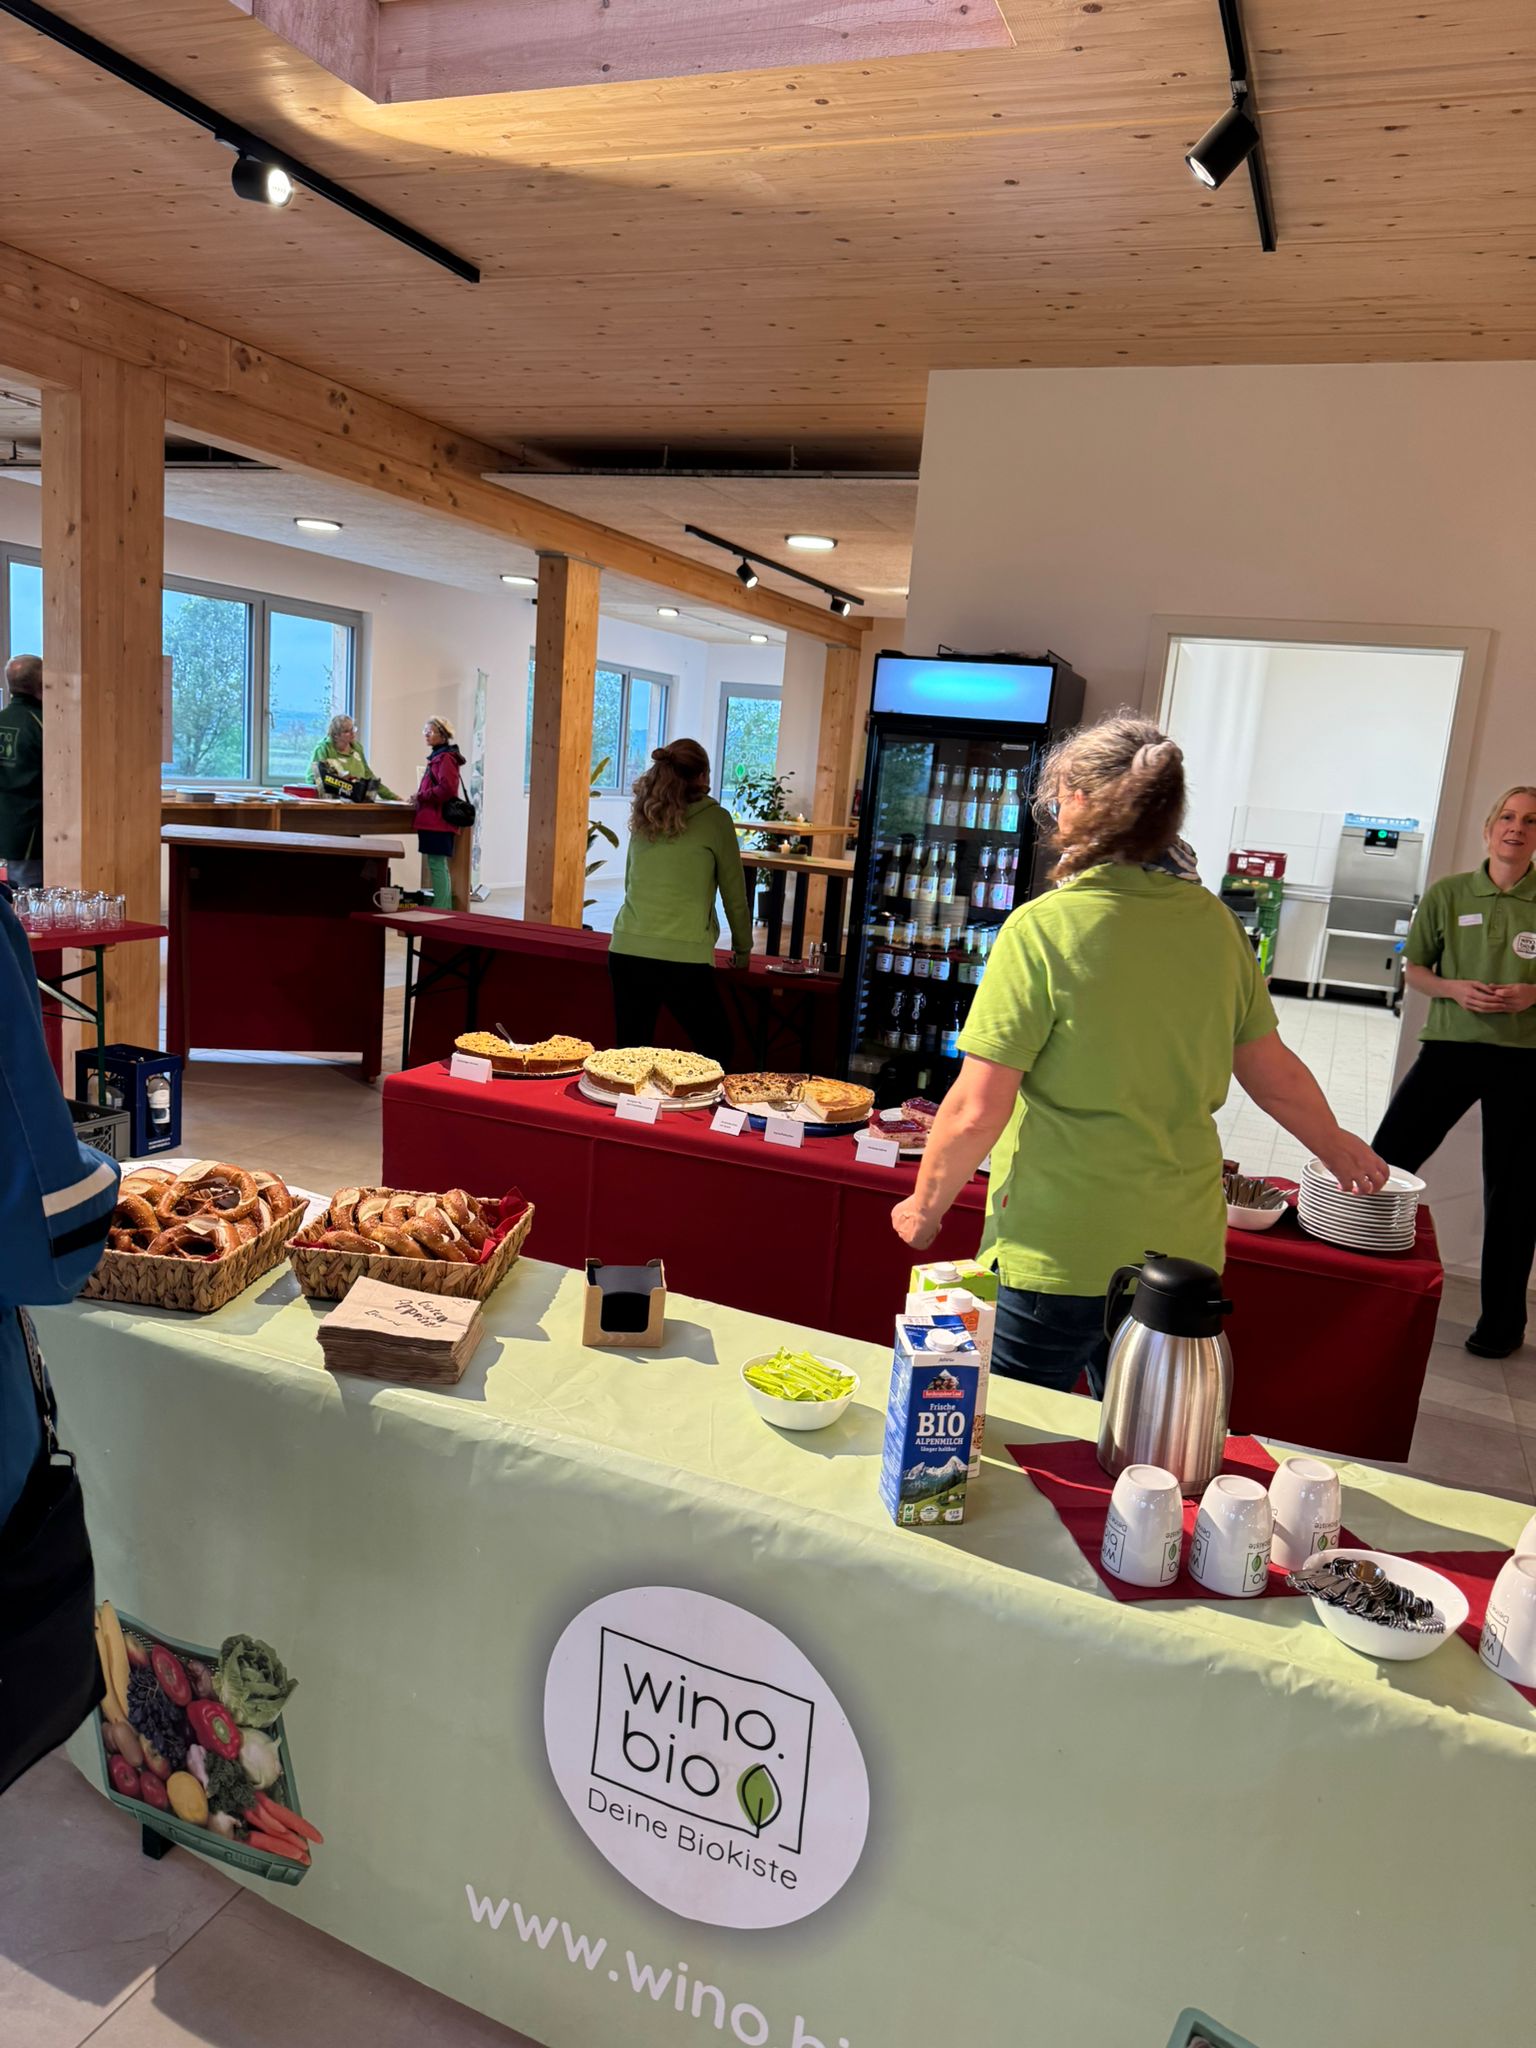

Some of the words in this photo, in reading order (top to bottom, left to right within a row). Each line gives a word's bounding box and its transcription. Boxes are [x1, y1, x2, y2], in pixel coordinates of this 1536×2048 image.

[916, 1411, 966, 1437] BIO
[929, 1403, 956, 1411] Frische
[915, 1437, 964, 1445] ALPENMILCH
[623, 1662, 787, 1761] wino.
[621, 1709, 721, 1798] bio
[587, 1787, 669, 1841] Deine
[677, 1823, 799, 1891] Biokiste
